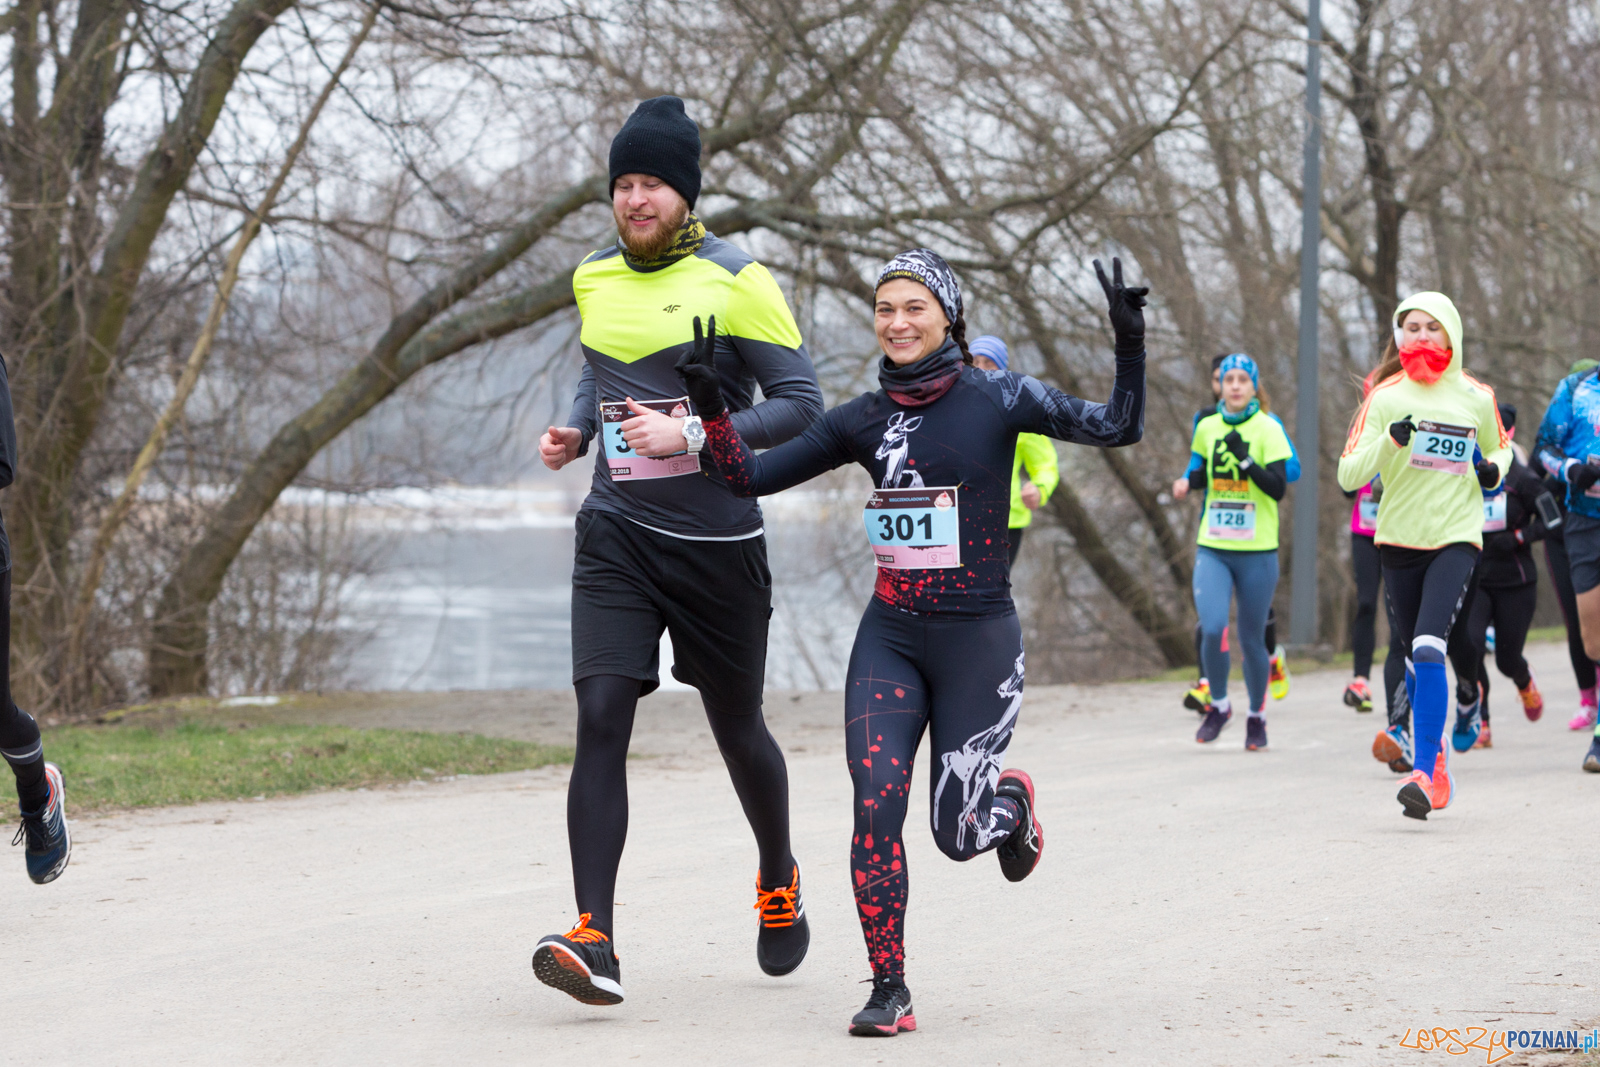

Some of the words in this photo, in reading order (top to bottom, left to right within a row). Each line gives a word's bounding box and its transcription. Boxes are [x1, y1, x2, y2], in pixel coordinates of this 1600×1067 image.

[887, 270, 925, 283] CHARAKTER
[662, 304, 682, 314] 4F
[1425, 436, 1467, 458] 299
[1216, 512, 1245, 526] 128
[877, 513, 933, 541] 301
